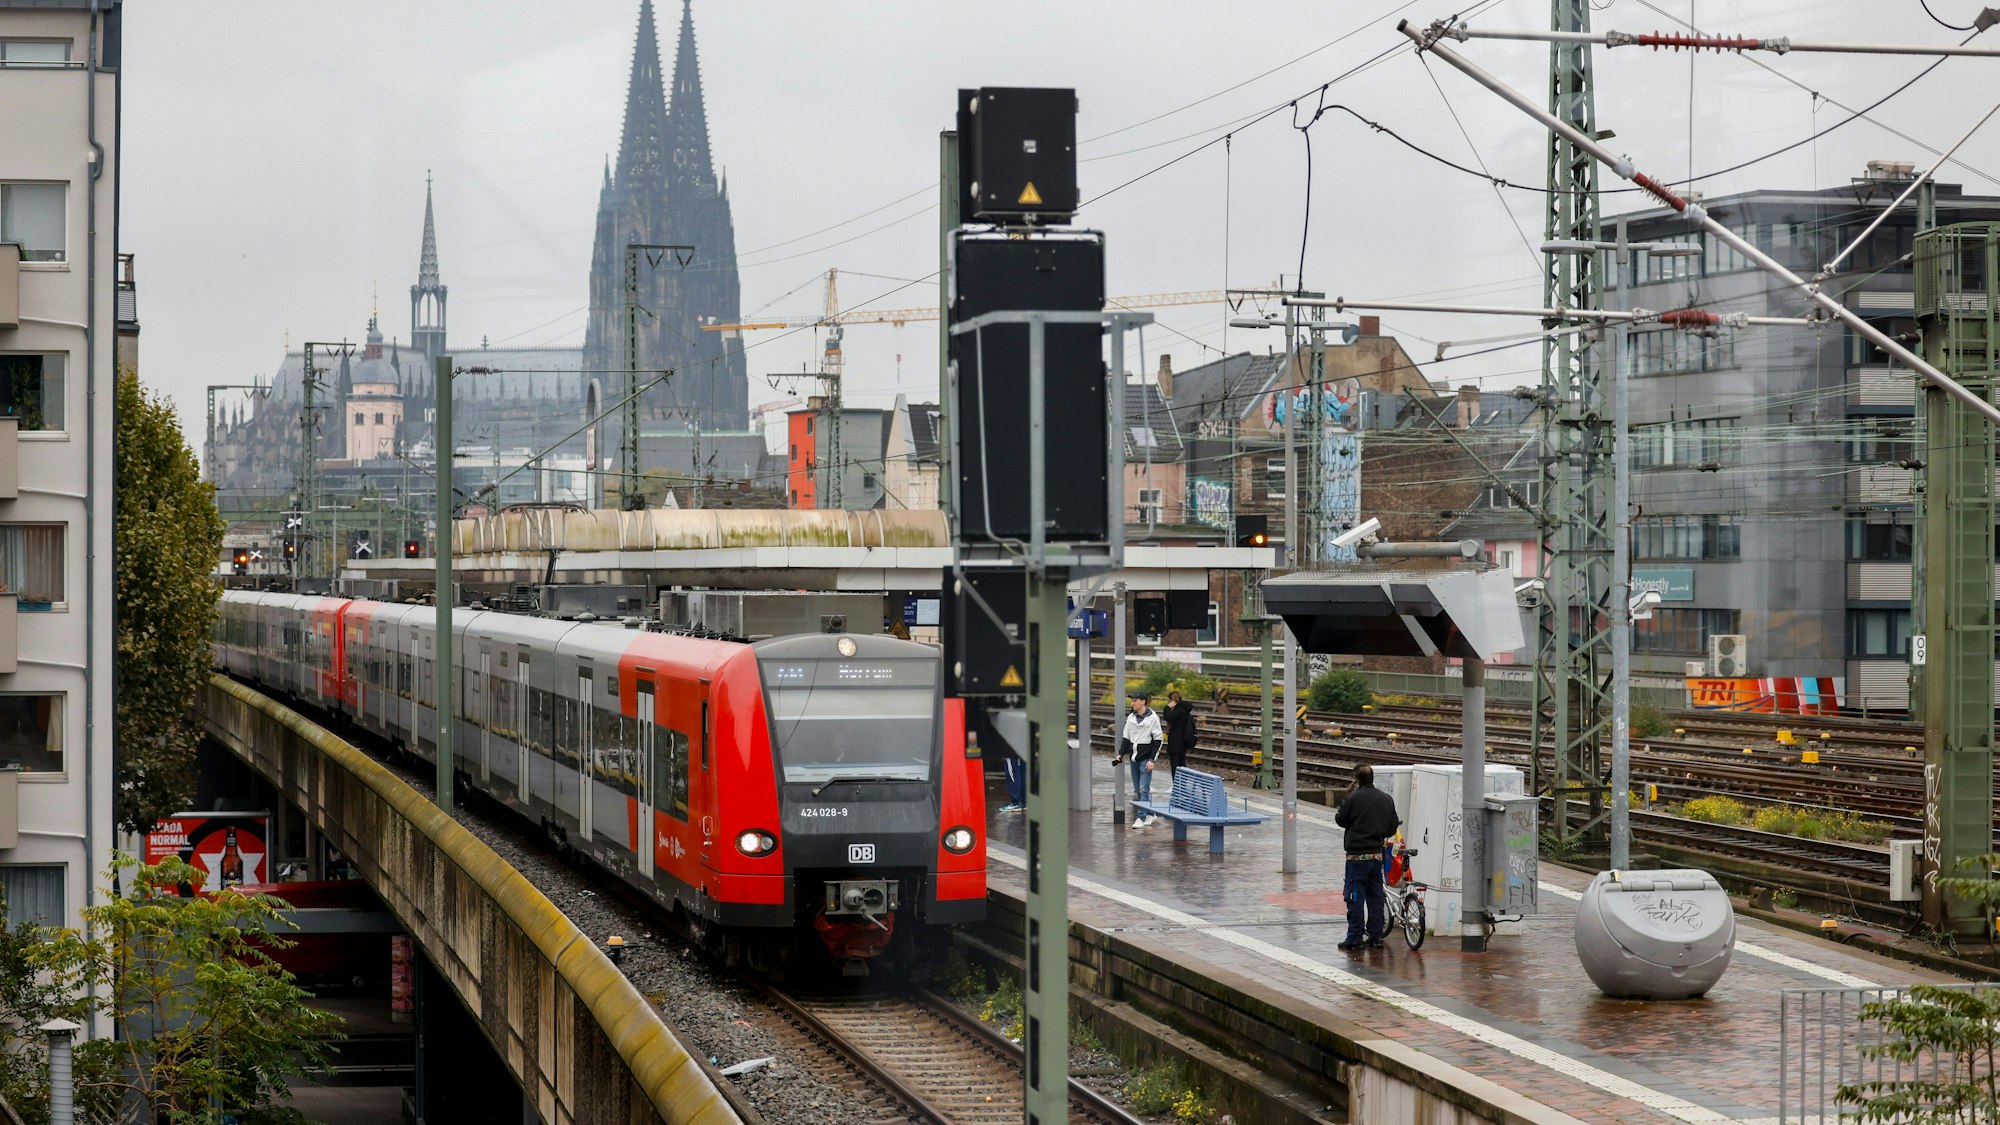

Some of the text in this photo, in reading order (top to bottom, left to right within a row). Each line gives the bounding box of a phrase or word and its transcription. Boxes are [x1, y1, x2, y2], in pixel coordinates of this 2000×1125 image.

[1635, 576, 1670, 594] Honestly
[801, 807, 848, 817] 424 028-9
[150, 834, 191, 845] NORMAL
[851, 846, 873, 861] DB
